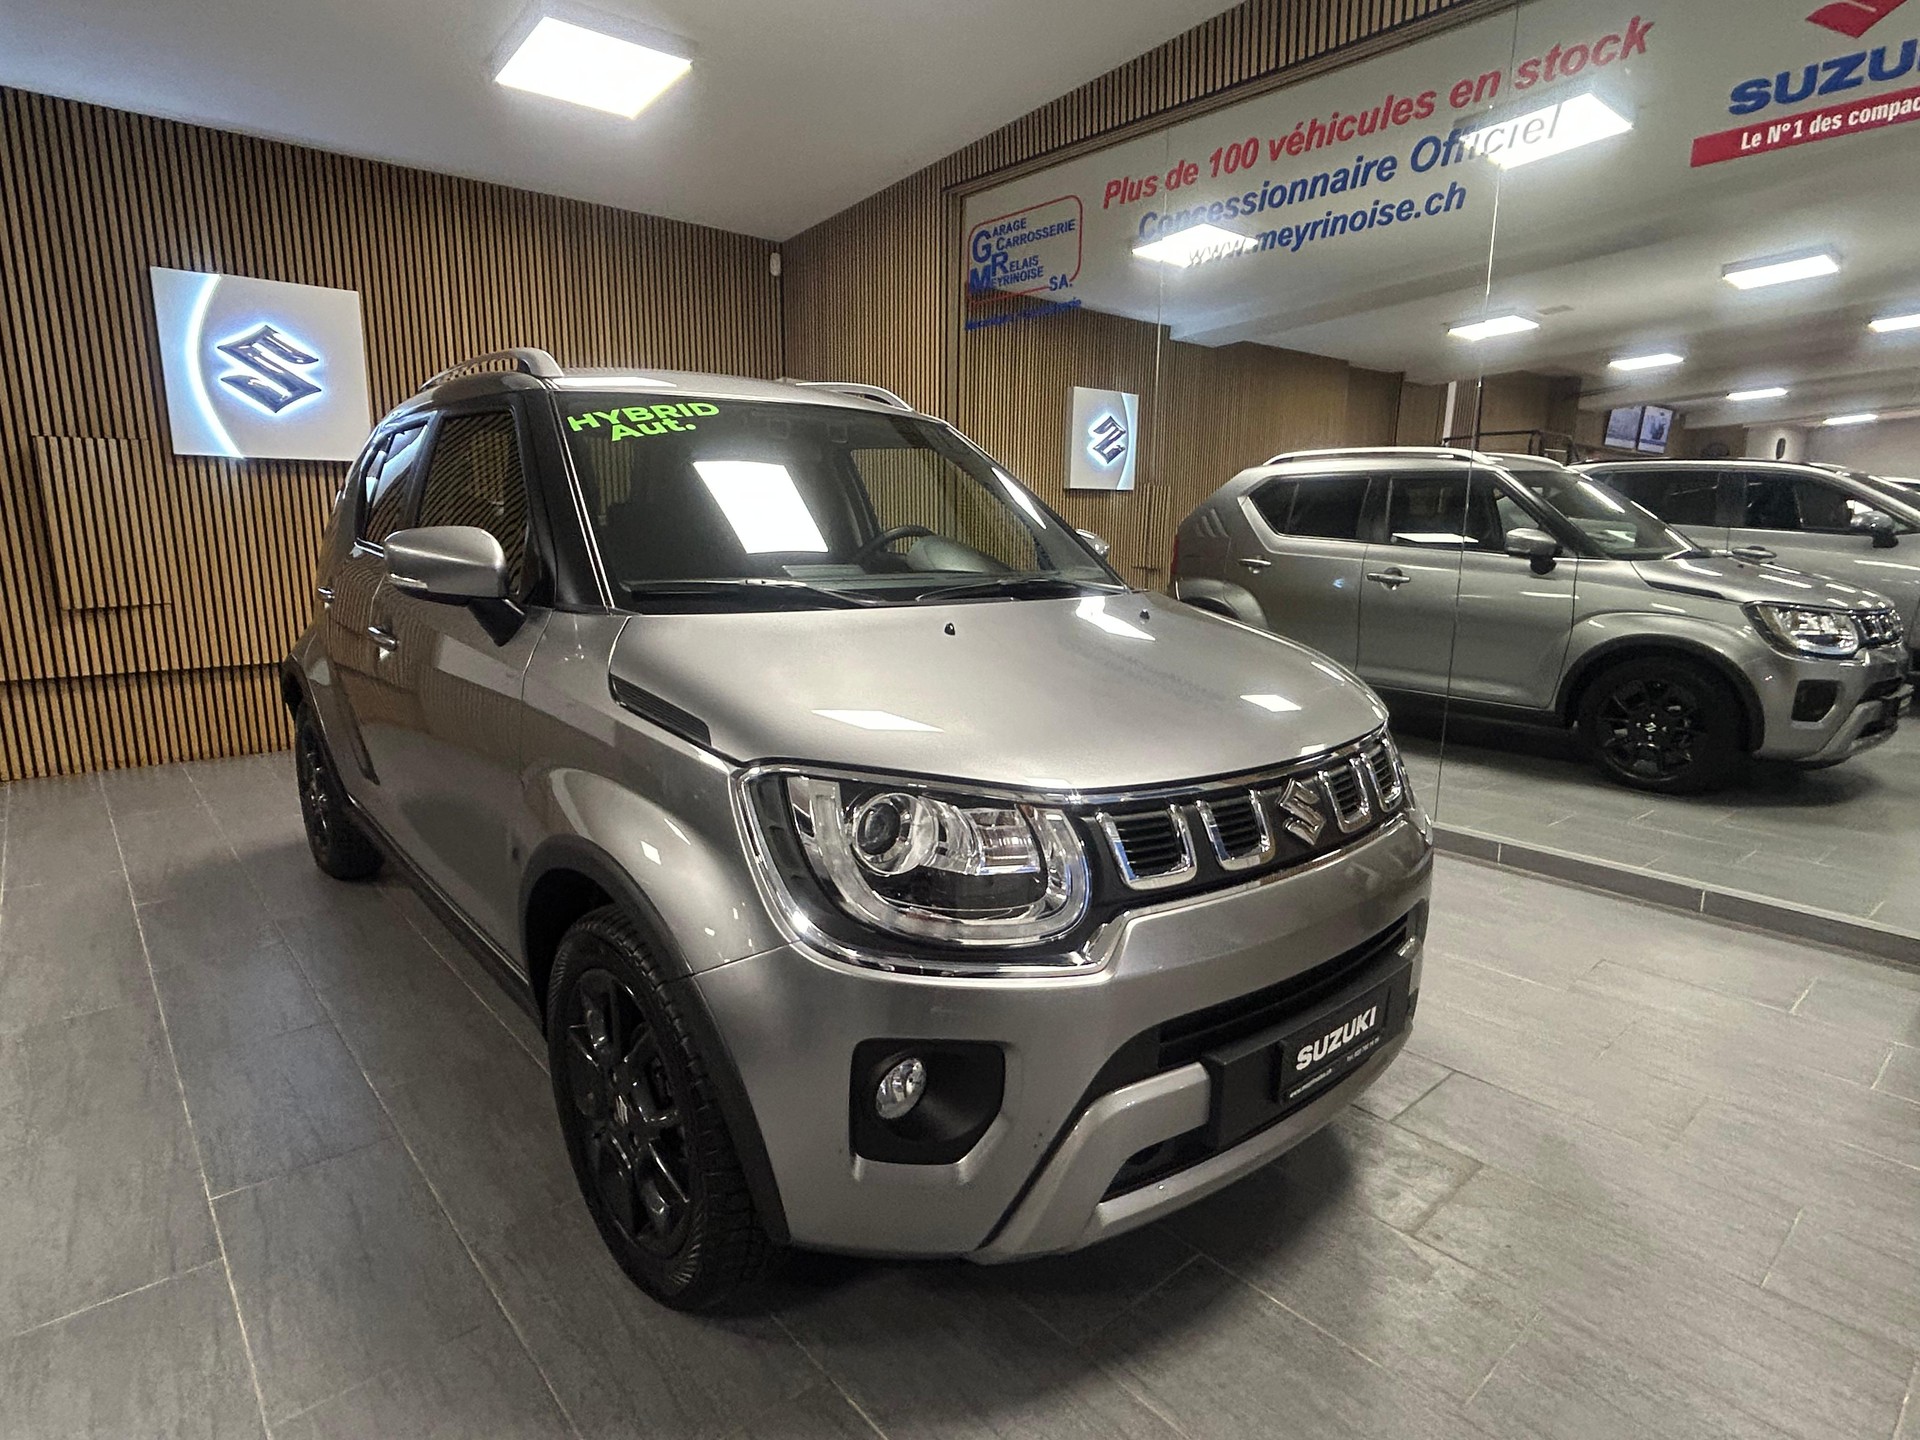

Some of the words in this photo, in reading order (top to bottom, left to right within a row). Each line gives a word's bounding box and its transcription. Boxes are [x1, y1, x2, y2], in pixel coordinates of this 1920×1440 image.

[1728, 38, 1920, 115] SUZU
[1103, 174, 1157, 209] Plus
[1165, 159, 1199, 192] de
[1209, 136, 1260, 178] 100
[1268, 88, 1437, 162] véhicules
[1449, 69, 1501, 109] en
[1513, 15, 1655, 91] stock
[1740, 131, 1763, 150] Le
[1809, 113, 1843, 135] des
[1138, 155, 1398, 242] Concessionnaire
[996, 219, 1077, 251] CARROSSERIE
[567, 402, 720, 432] HYBRID
[611, 418, 697, 442] Aut.
[1295, 1005, 1378, 1071] SUZUKI
